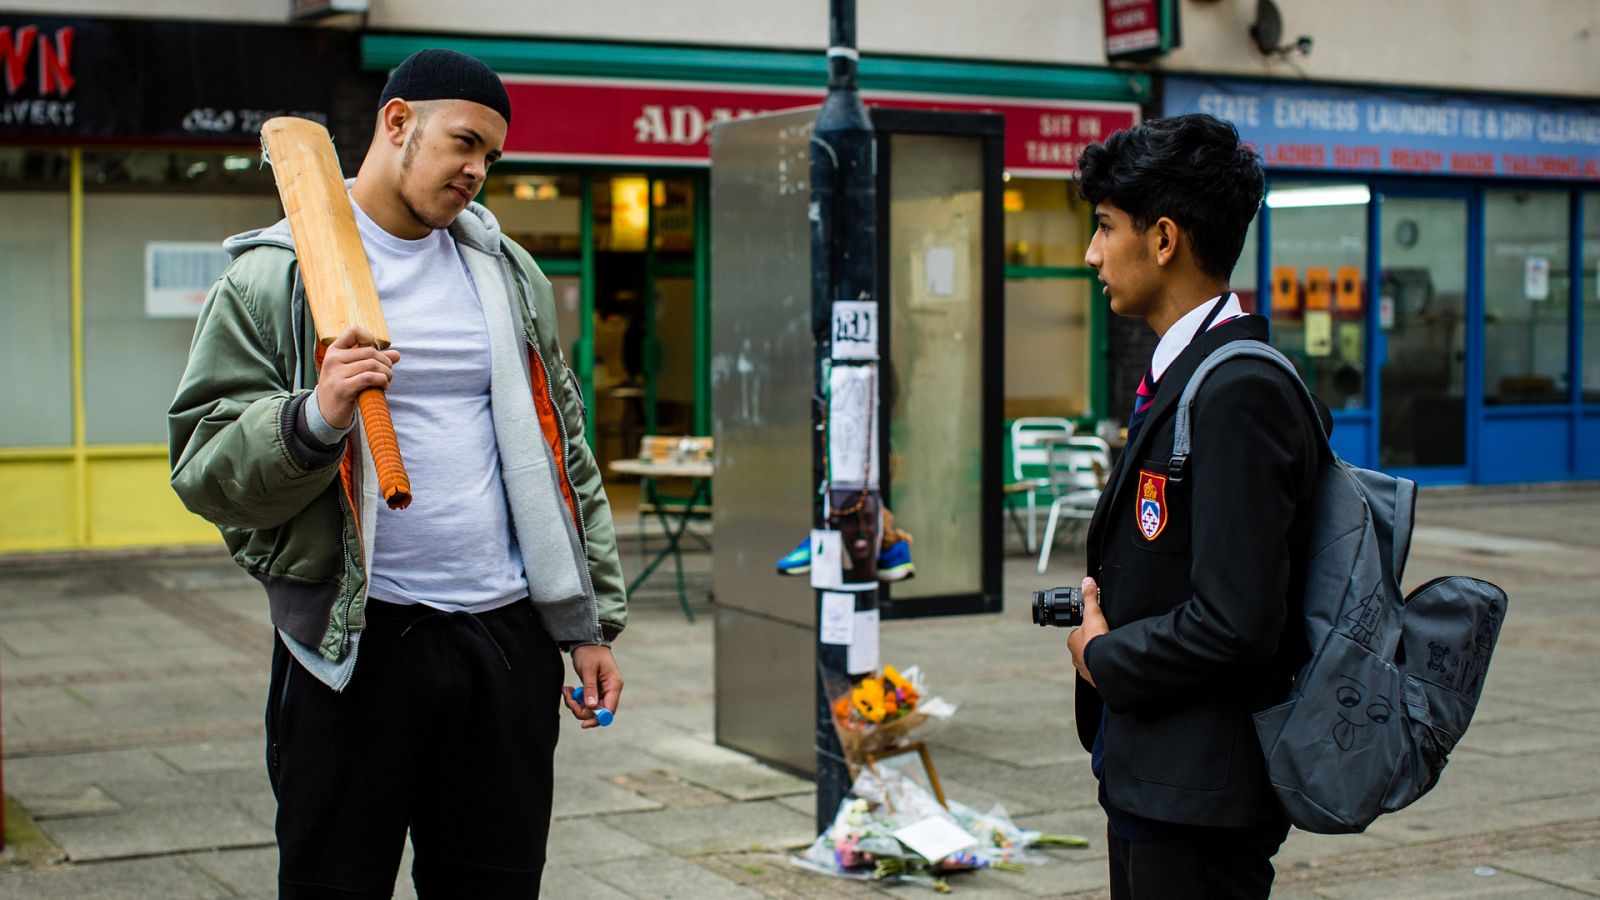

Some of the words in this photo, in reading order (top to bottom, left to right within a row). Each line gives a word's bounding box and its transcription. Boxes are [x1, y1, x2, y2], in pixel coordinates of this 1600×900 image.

[0, 99, 77, 127] IVERY
[1039, 113, 1073, 137] SIT
[1078, 116, 1101, 138] IN
[1198, 94, 1260, 127] STATE
[1272, 97, 1360, 131] EXPRESS
[1265, 143, 1325, 167] LADIES
[1334, 144, 1382, 169] SUITS
[1391, 148, 1443, 170] READY
[1450, 151, 1496, 175] MADE
